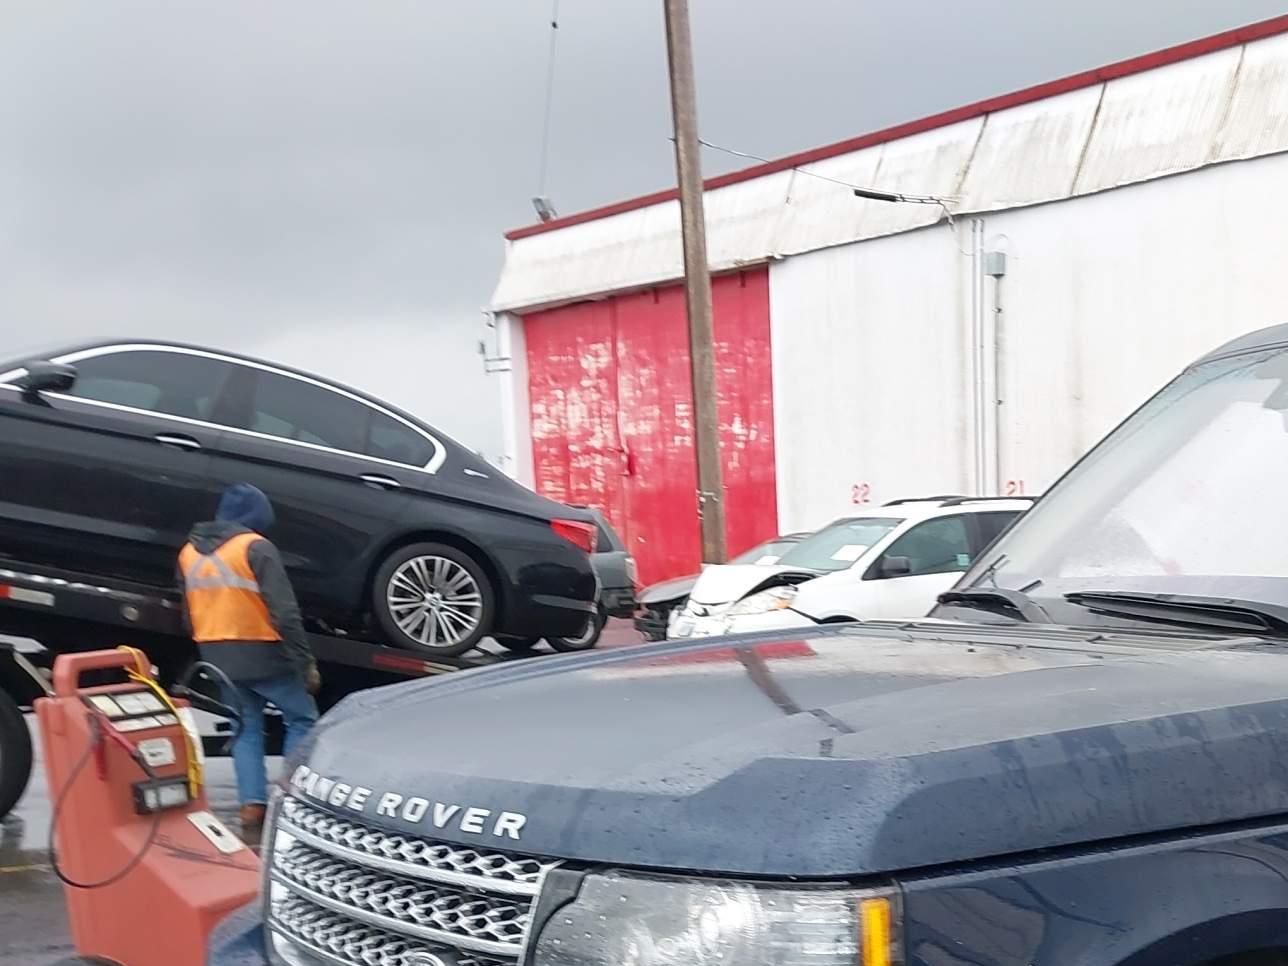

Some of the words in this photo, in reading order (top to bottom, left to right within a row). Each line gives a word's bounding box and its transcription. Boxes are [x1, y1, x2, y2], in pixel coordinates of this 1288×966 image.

[851, 483, 870, 504] 22
[1005, 479, 1024, 496] 21
[290, 764, 372, 813] RANGE
[376, 791, 528, 840] ROVER
